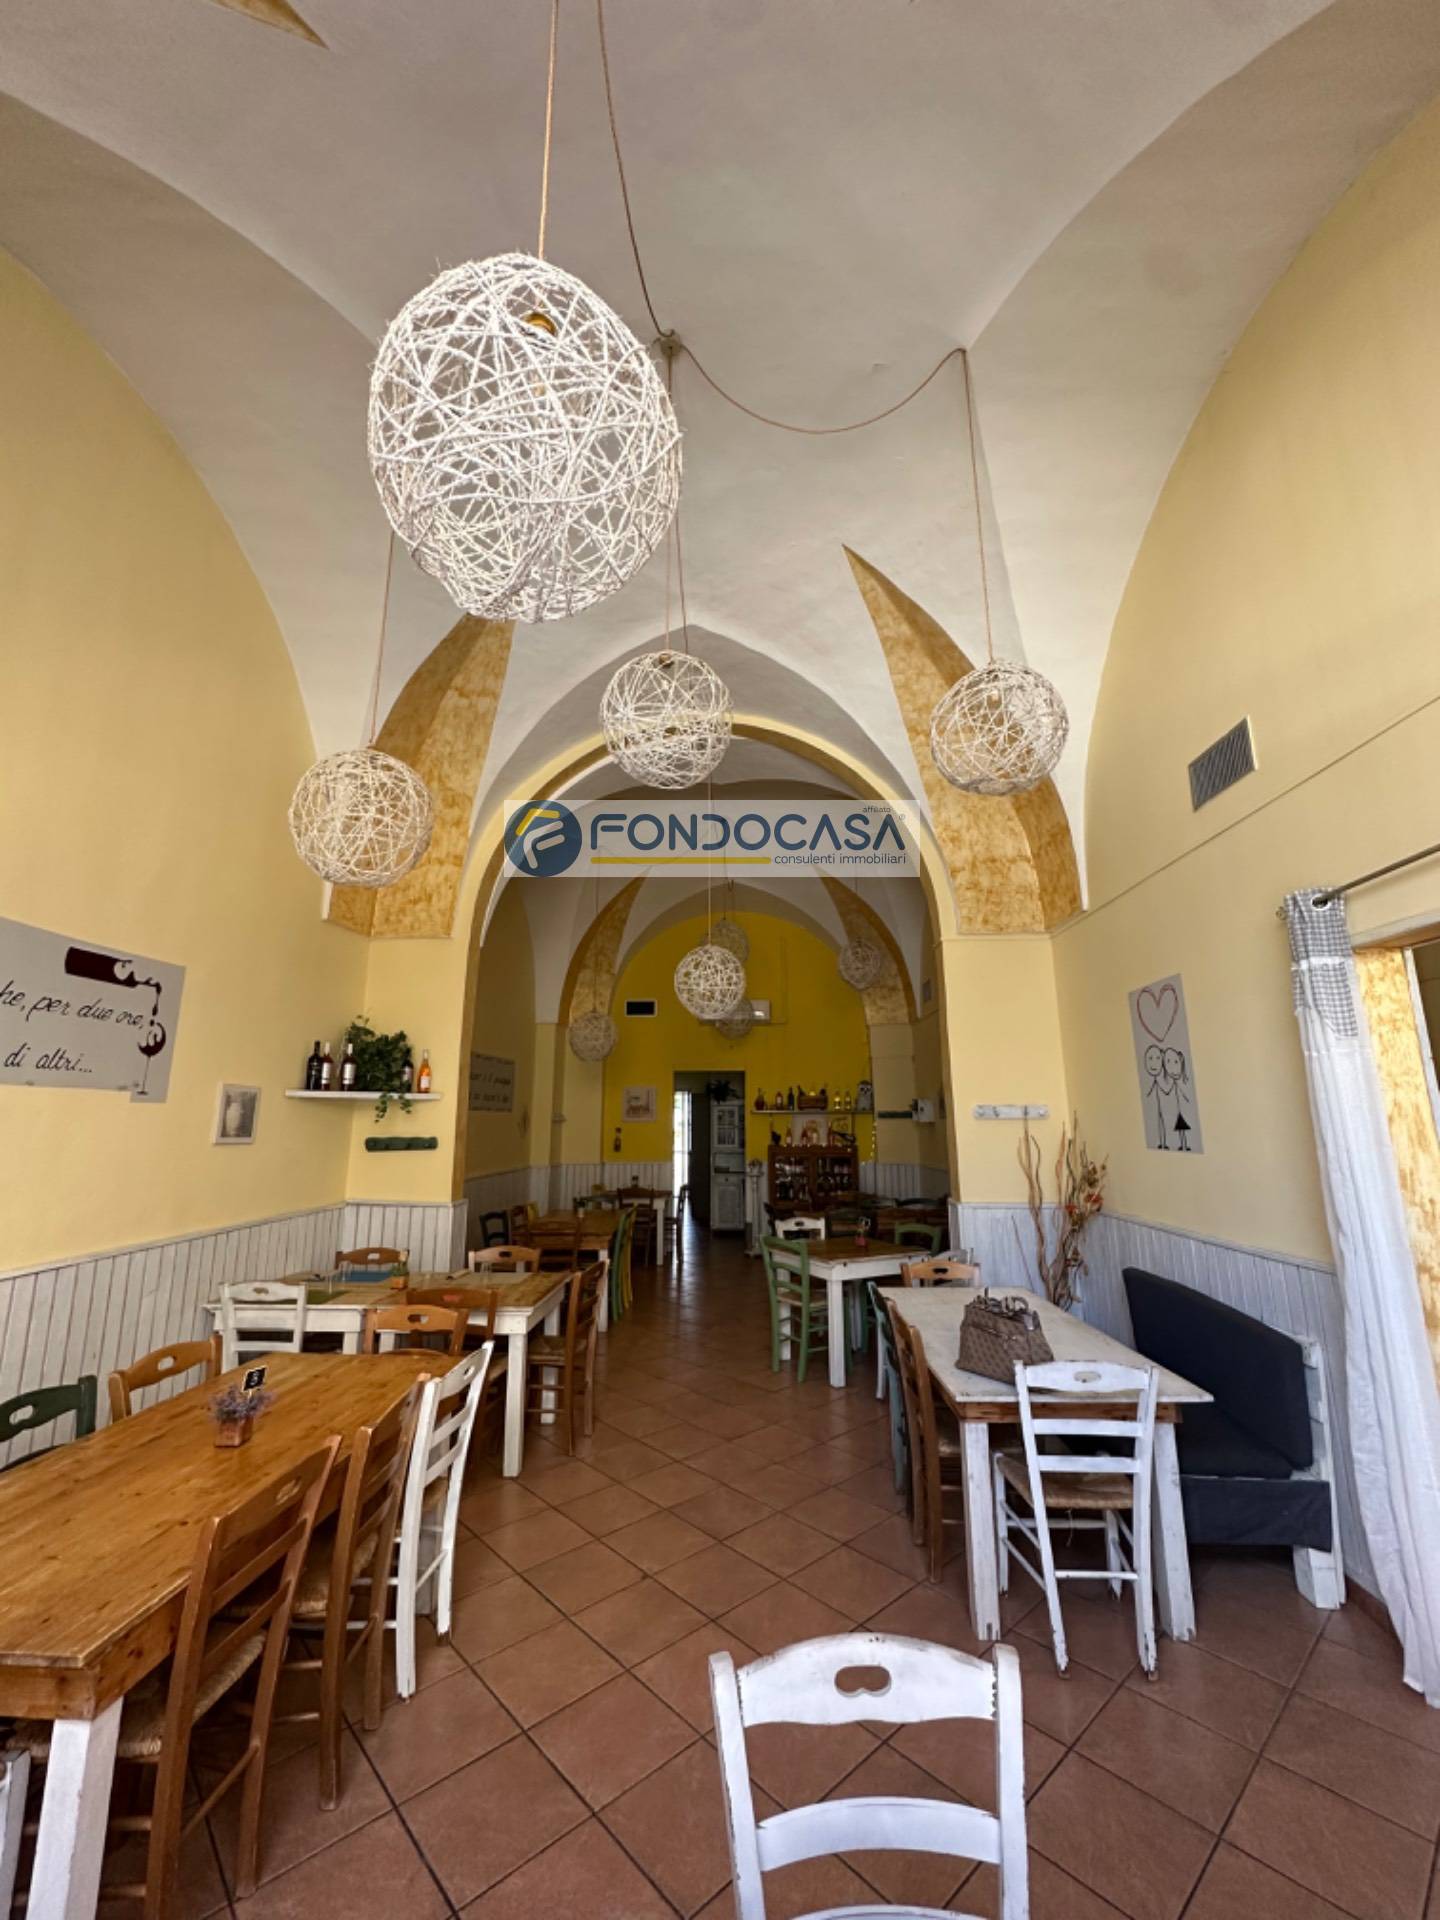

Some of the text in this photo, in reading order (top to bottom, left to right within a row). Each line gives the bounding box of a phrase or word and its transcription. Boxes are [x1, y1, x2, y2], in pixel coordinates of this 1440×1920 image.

[26, 996, 70, 1022] per
[77, 998, 114, 1021] due
[4, 1042, 31, 1068] di
